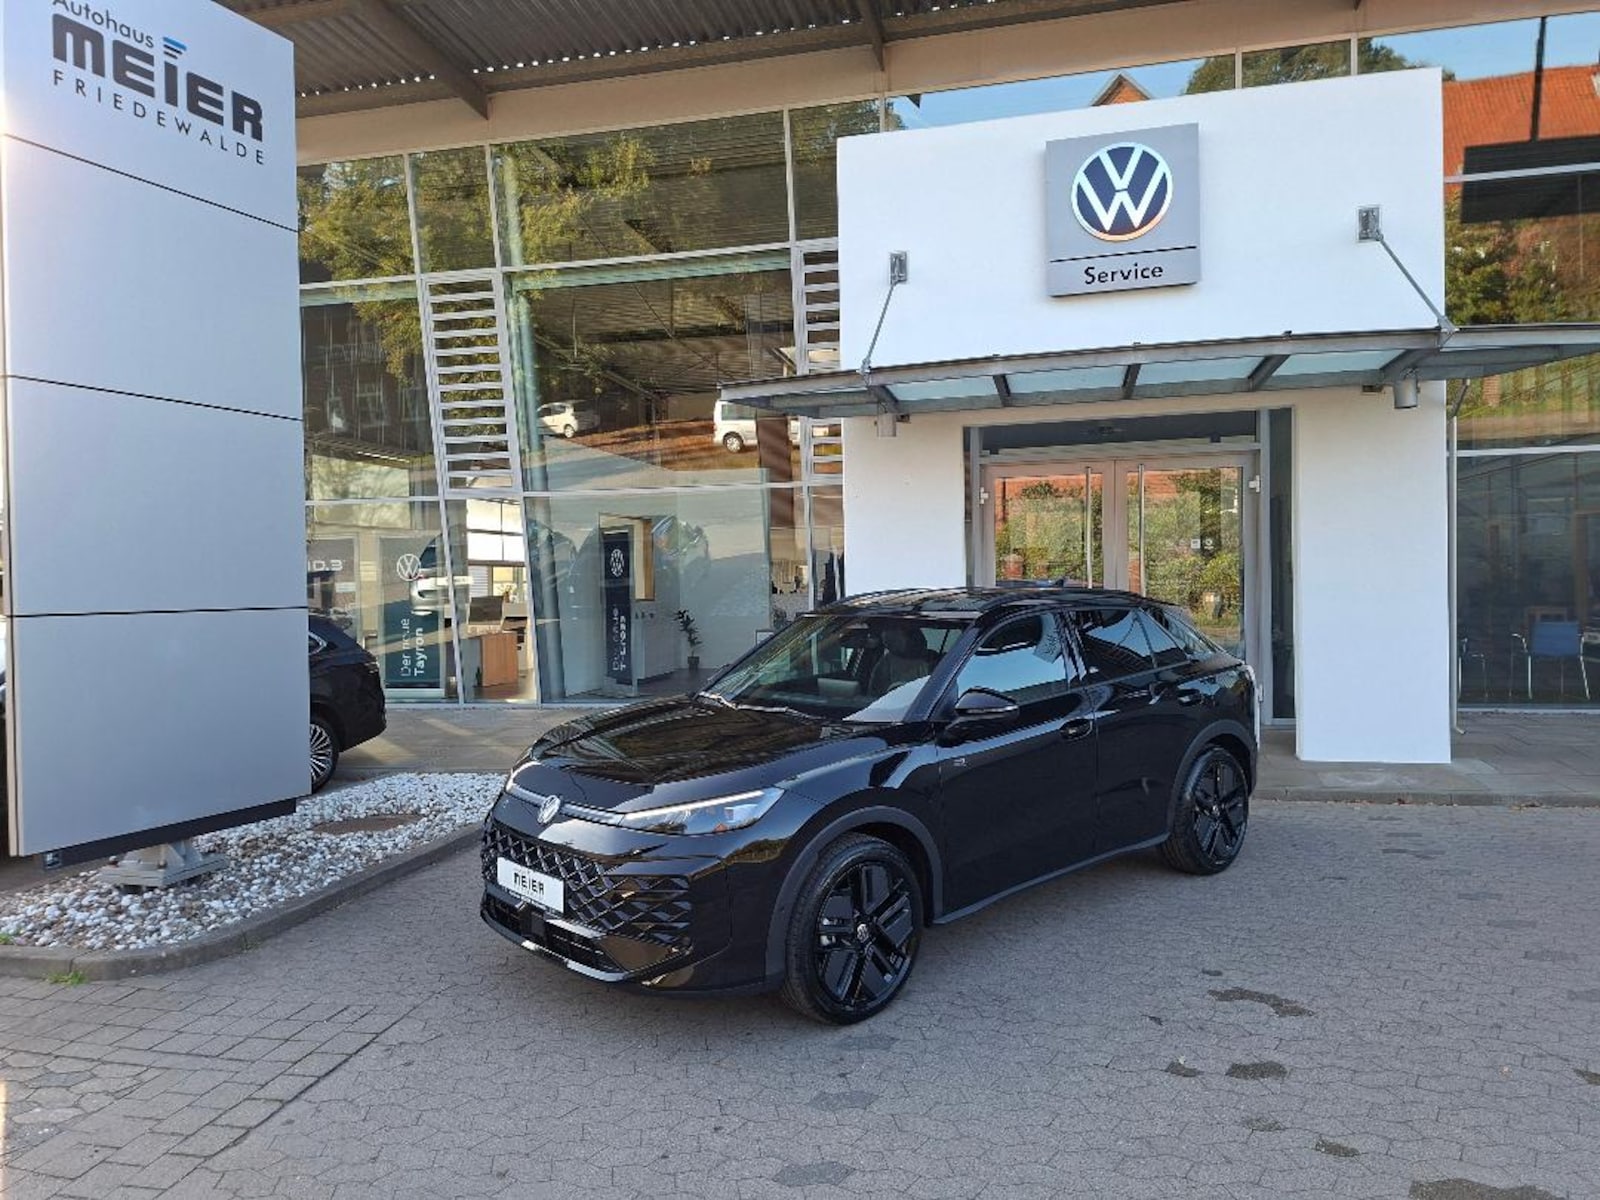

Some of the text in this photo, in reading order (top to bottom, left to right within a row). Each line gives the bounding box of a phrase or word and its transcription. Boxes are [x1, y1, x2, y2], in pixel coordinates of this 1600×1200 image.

[52, 13, 263, 142] MEIER
[53, 69, 264, 165] FRIEDEWALDE
[1083, 262, 1164, 285] Service
[413, 627, 427, 677] Tayron
